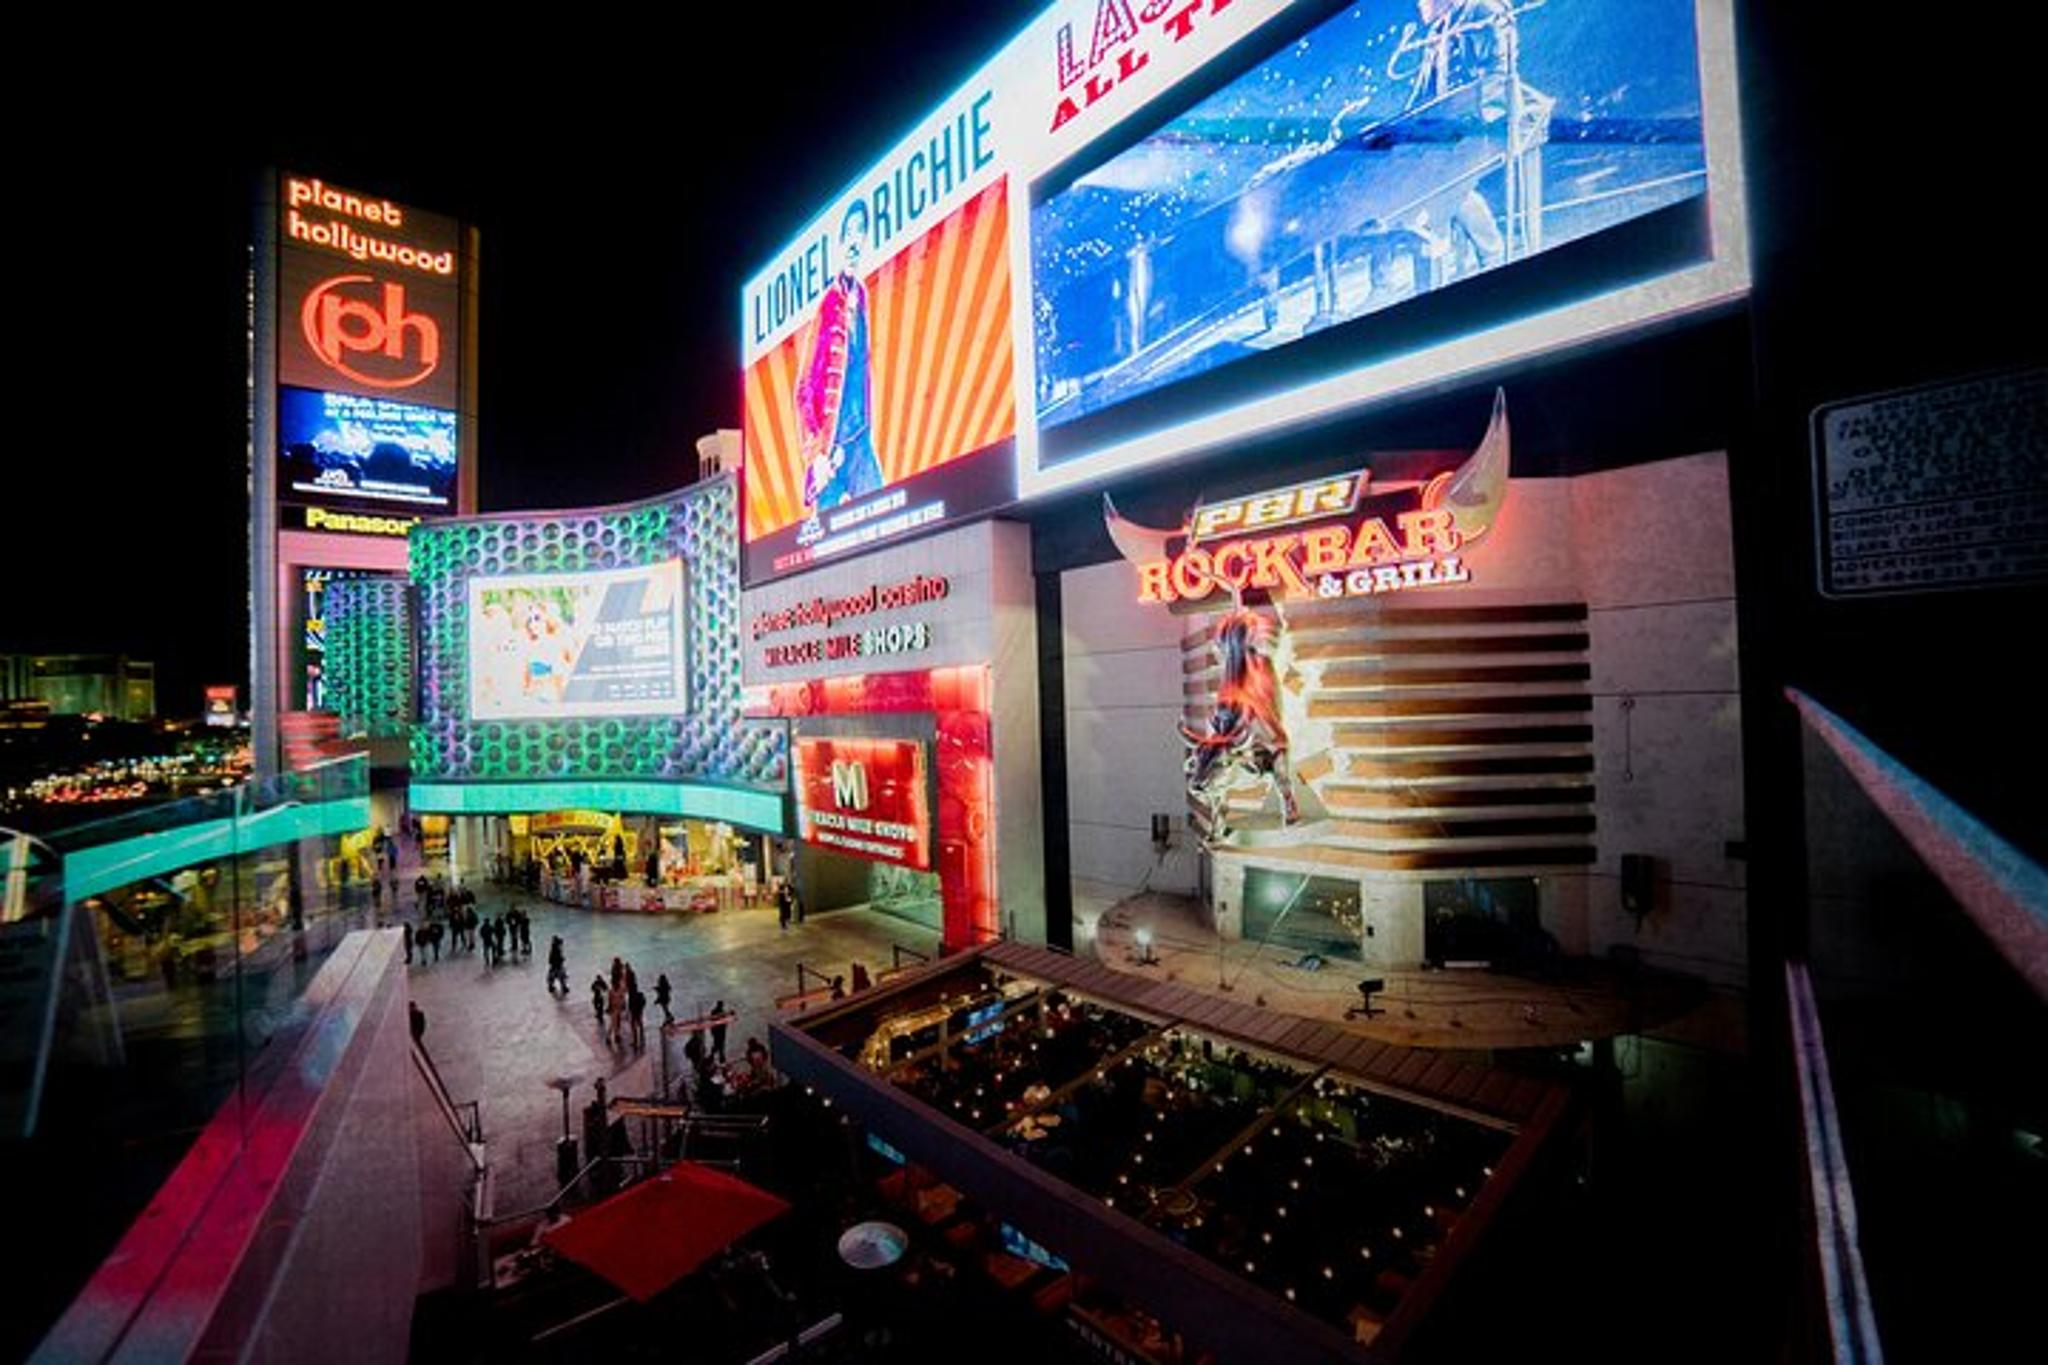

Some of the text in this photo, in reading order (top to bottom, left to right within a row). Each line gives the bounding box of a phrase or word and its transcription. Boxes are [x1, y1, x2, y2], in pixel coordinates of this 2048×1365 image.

[1049, 0, 1236, 134] ALL T
[288, 178, 402, 227] planet
[755, 89, 994, 344] LIONEL RICHIE
[288, 210, 452, 274] hollywood
[308, 279, 440, 375] ph
[307, 507, 420, 535] Panason
[1197, 480, 1354, 538] PBR
[880, 575, 950, 610] casino
[1318, 556, 1470, 599] & GRILL
[825, 633, 863, 661] MILE
[862, 621, 929, 656] SHOPS
